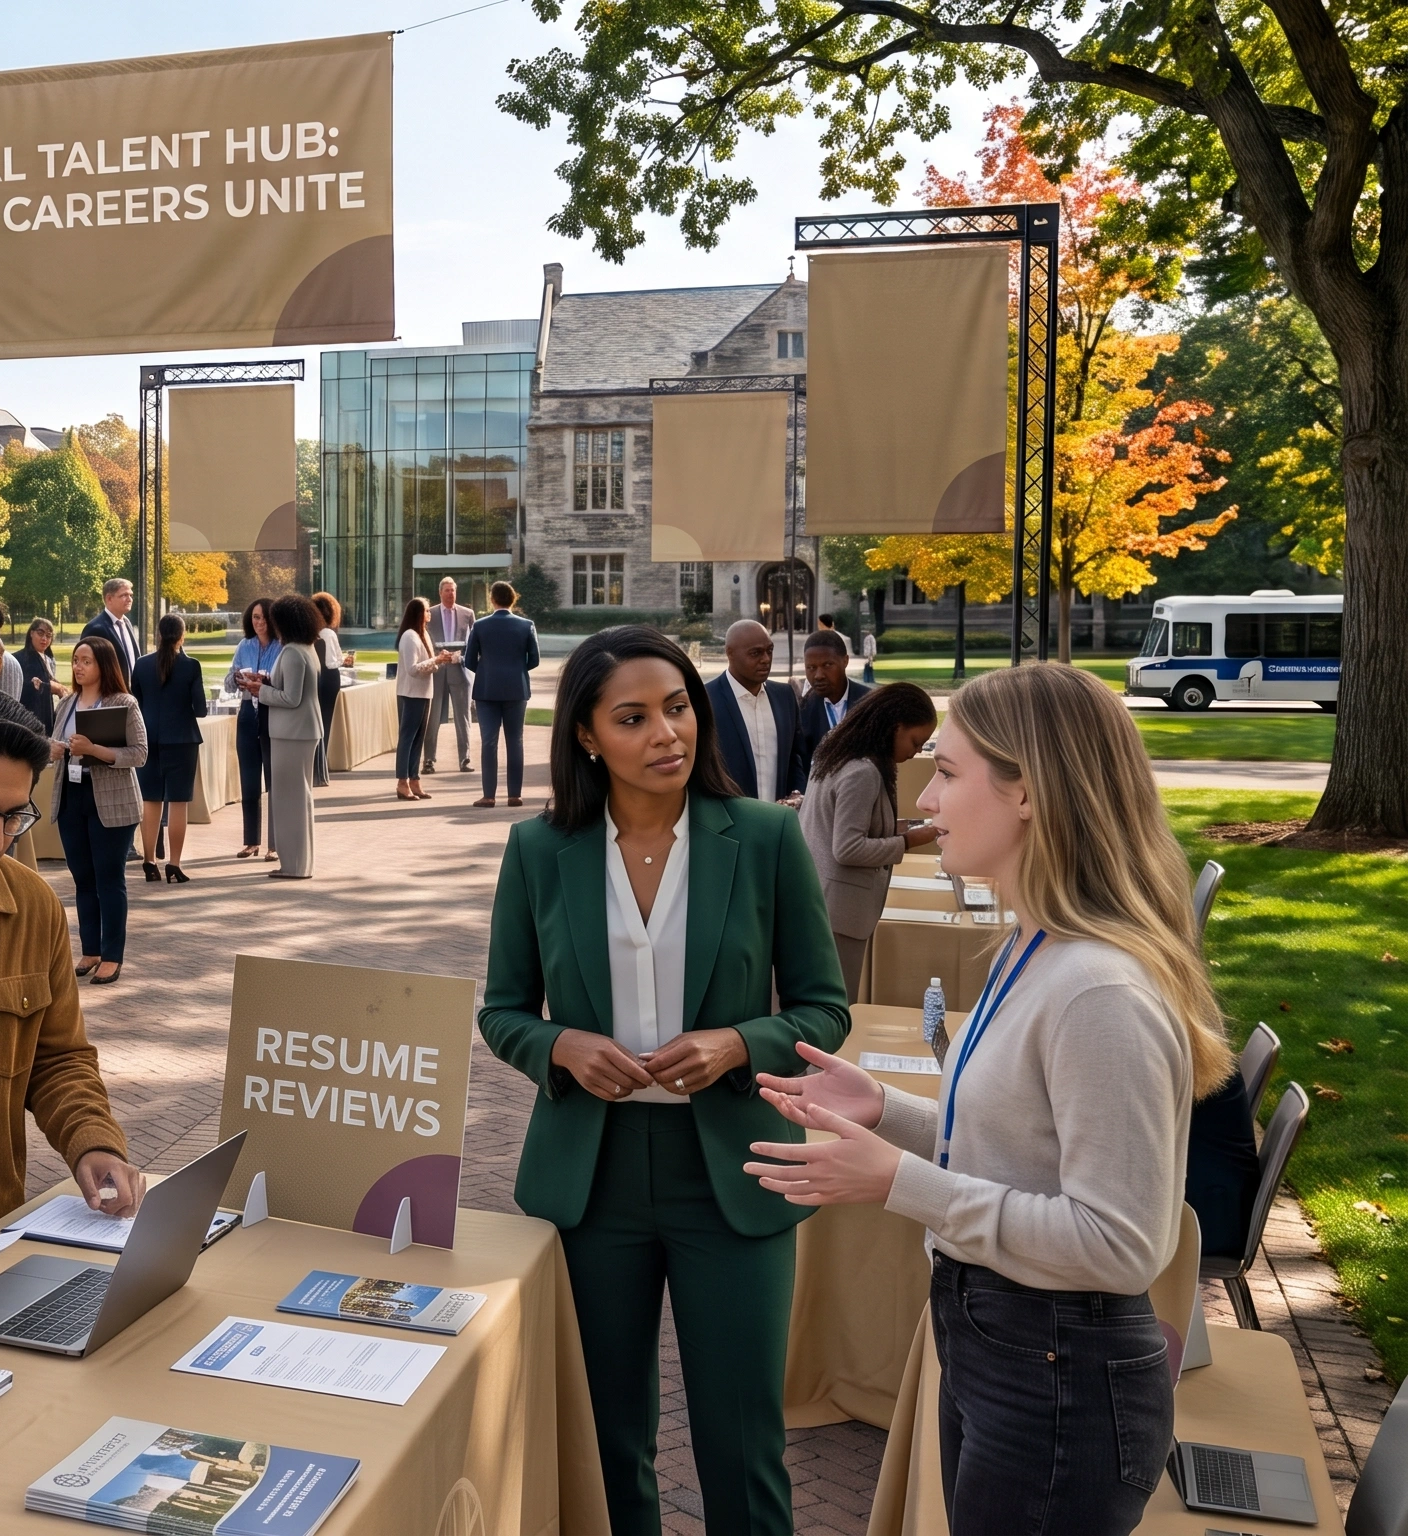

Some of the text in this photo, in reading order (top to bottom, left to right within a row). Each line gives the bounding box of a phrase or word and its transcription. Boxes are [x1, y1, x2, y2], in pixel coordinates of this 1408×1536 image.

[37, 130, 210, 179] TALENT
[225, 121, 340, 165] HUB:
[3, 183, 209, 232] CAREERS
[225, 170, 365, 218] UNITE
[256, 1027, 440, 1085] RESUME
[243, 1075, 441, 1137] REVIEWS
